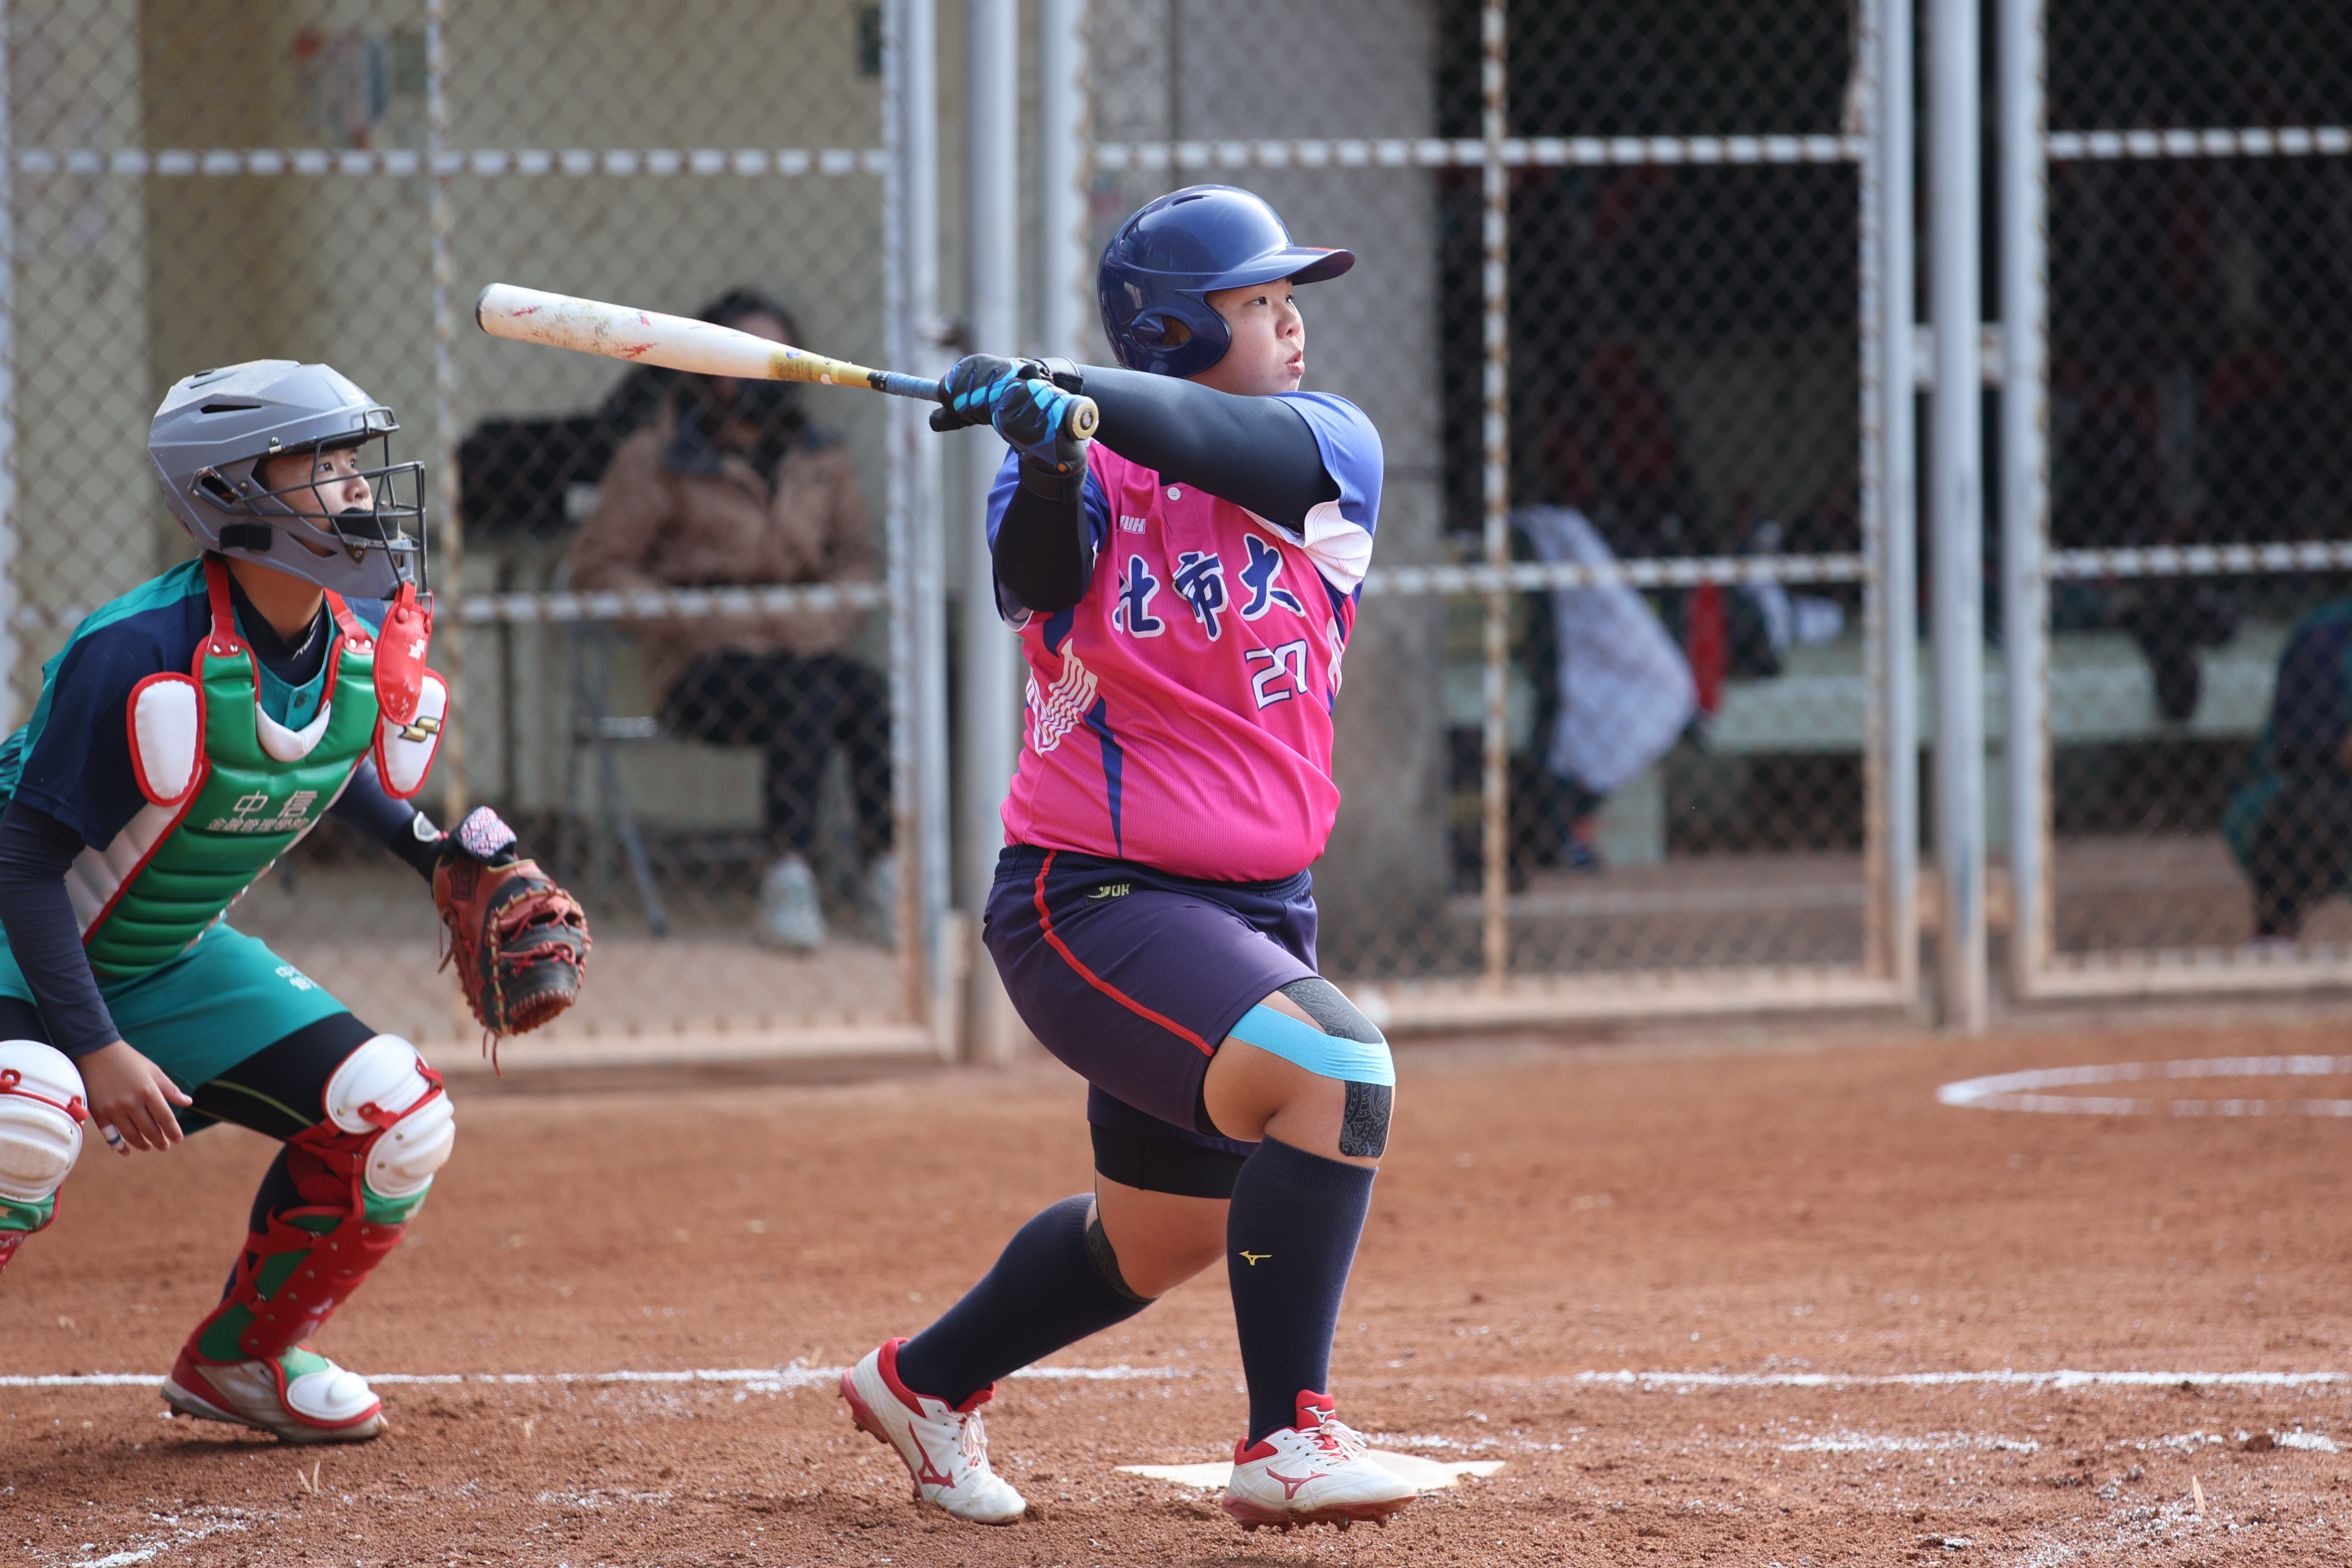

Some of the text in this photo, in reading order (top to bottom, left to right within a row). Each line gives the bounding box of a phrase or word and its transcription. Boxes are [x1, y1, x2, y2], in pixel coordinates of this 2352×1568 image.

[1112, 532, 1305, 642] 北市大
[1244, 638, 1308, 711] 27
[233, 790, 318, 819] 中信
